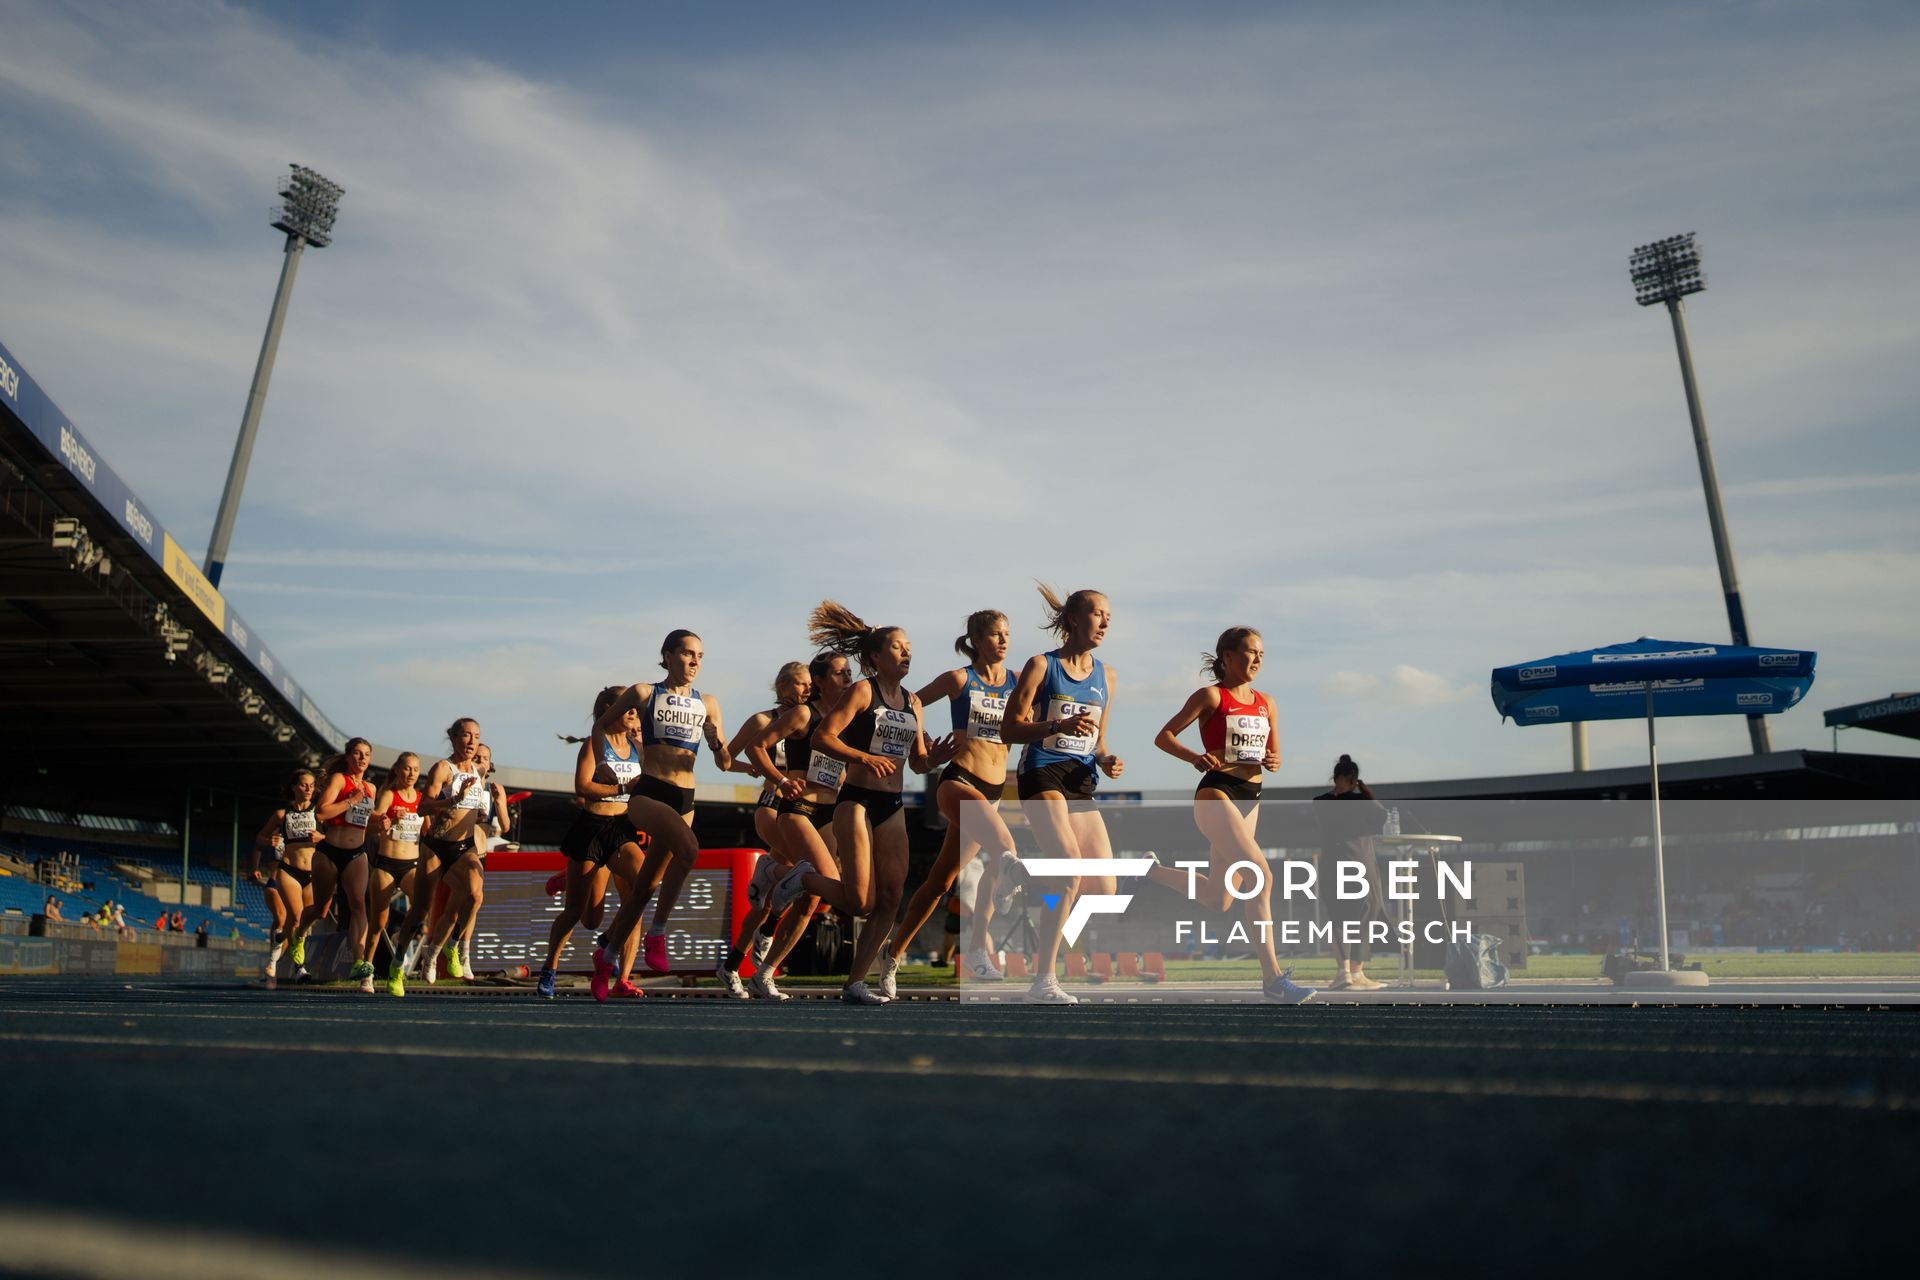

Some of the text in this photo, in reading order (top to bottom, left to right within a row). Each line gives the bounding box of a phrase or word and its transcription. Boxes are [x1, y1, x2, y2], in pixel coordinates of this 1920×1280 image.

[1534, 667, 1555, 675] PLAN
[666, 695, 692, 708] GLS
[982, 698, 1005, 710] GLS
[1857, 696, 1920, 719] VOLKSWAGE
[1060, 703, 1087, 715] GLS
[656, 709, 704, 728] SCHULTZ
[885, 711, 906, 723] GLS
[1237, 717, 1260, 729] GLS
[876, 724, 917, 743] SOETHOUT
[1231, 733, 1266, 748] DREES
[614, 763, 632, 773] GLS
